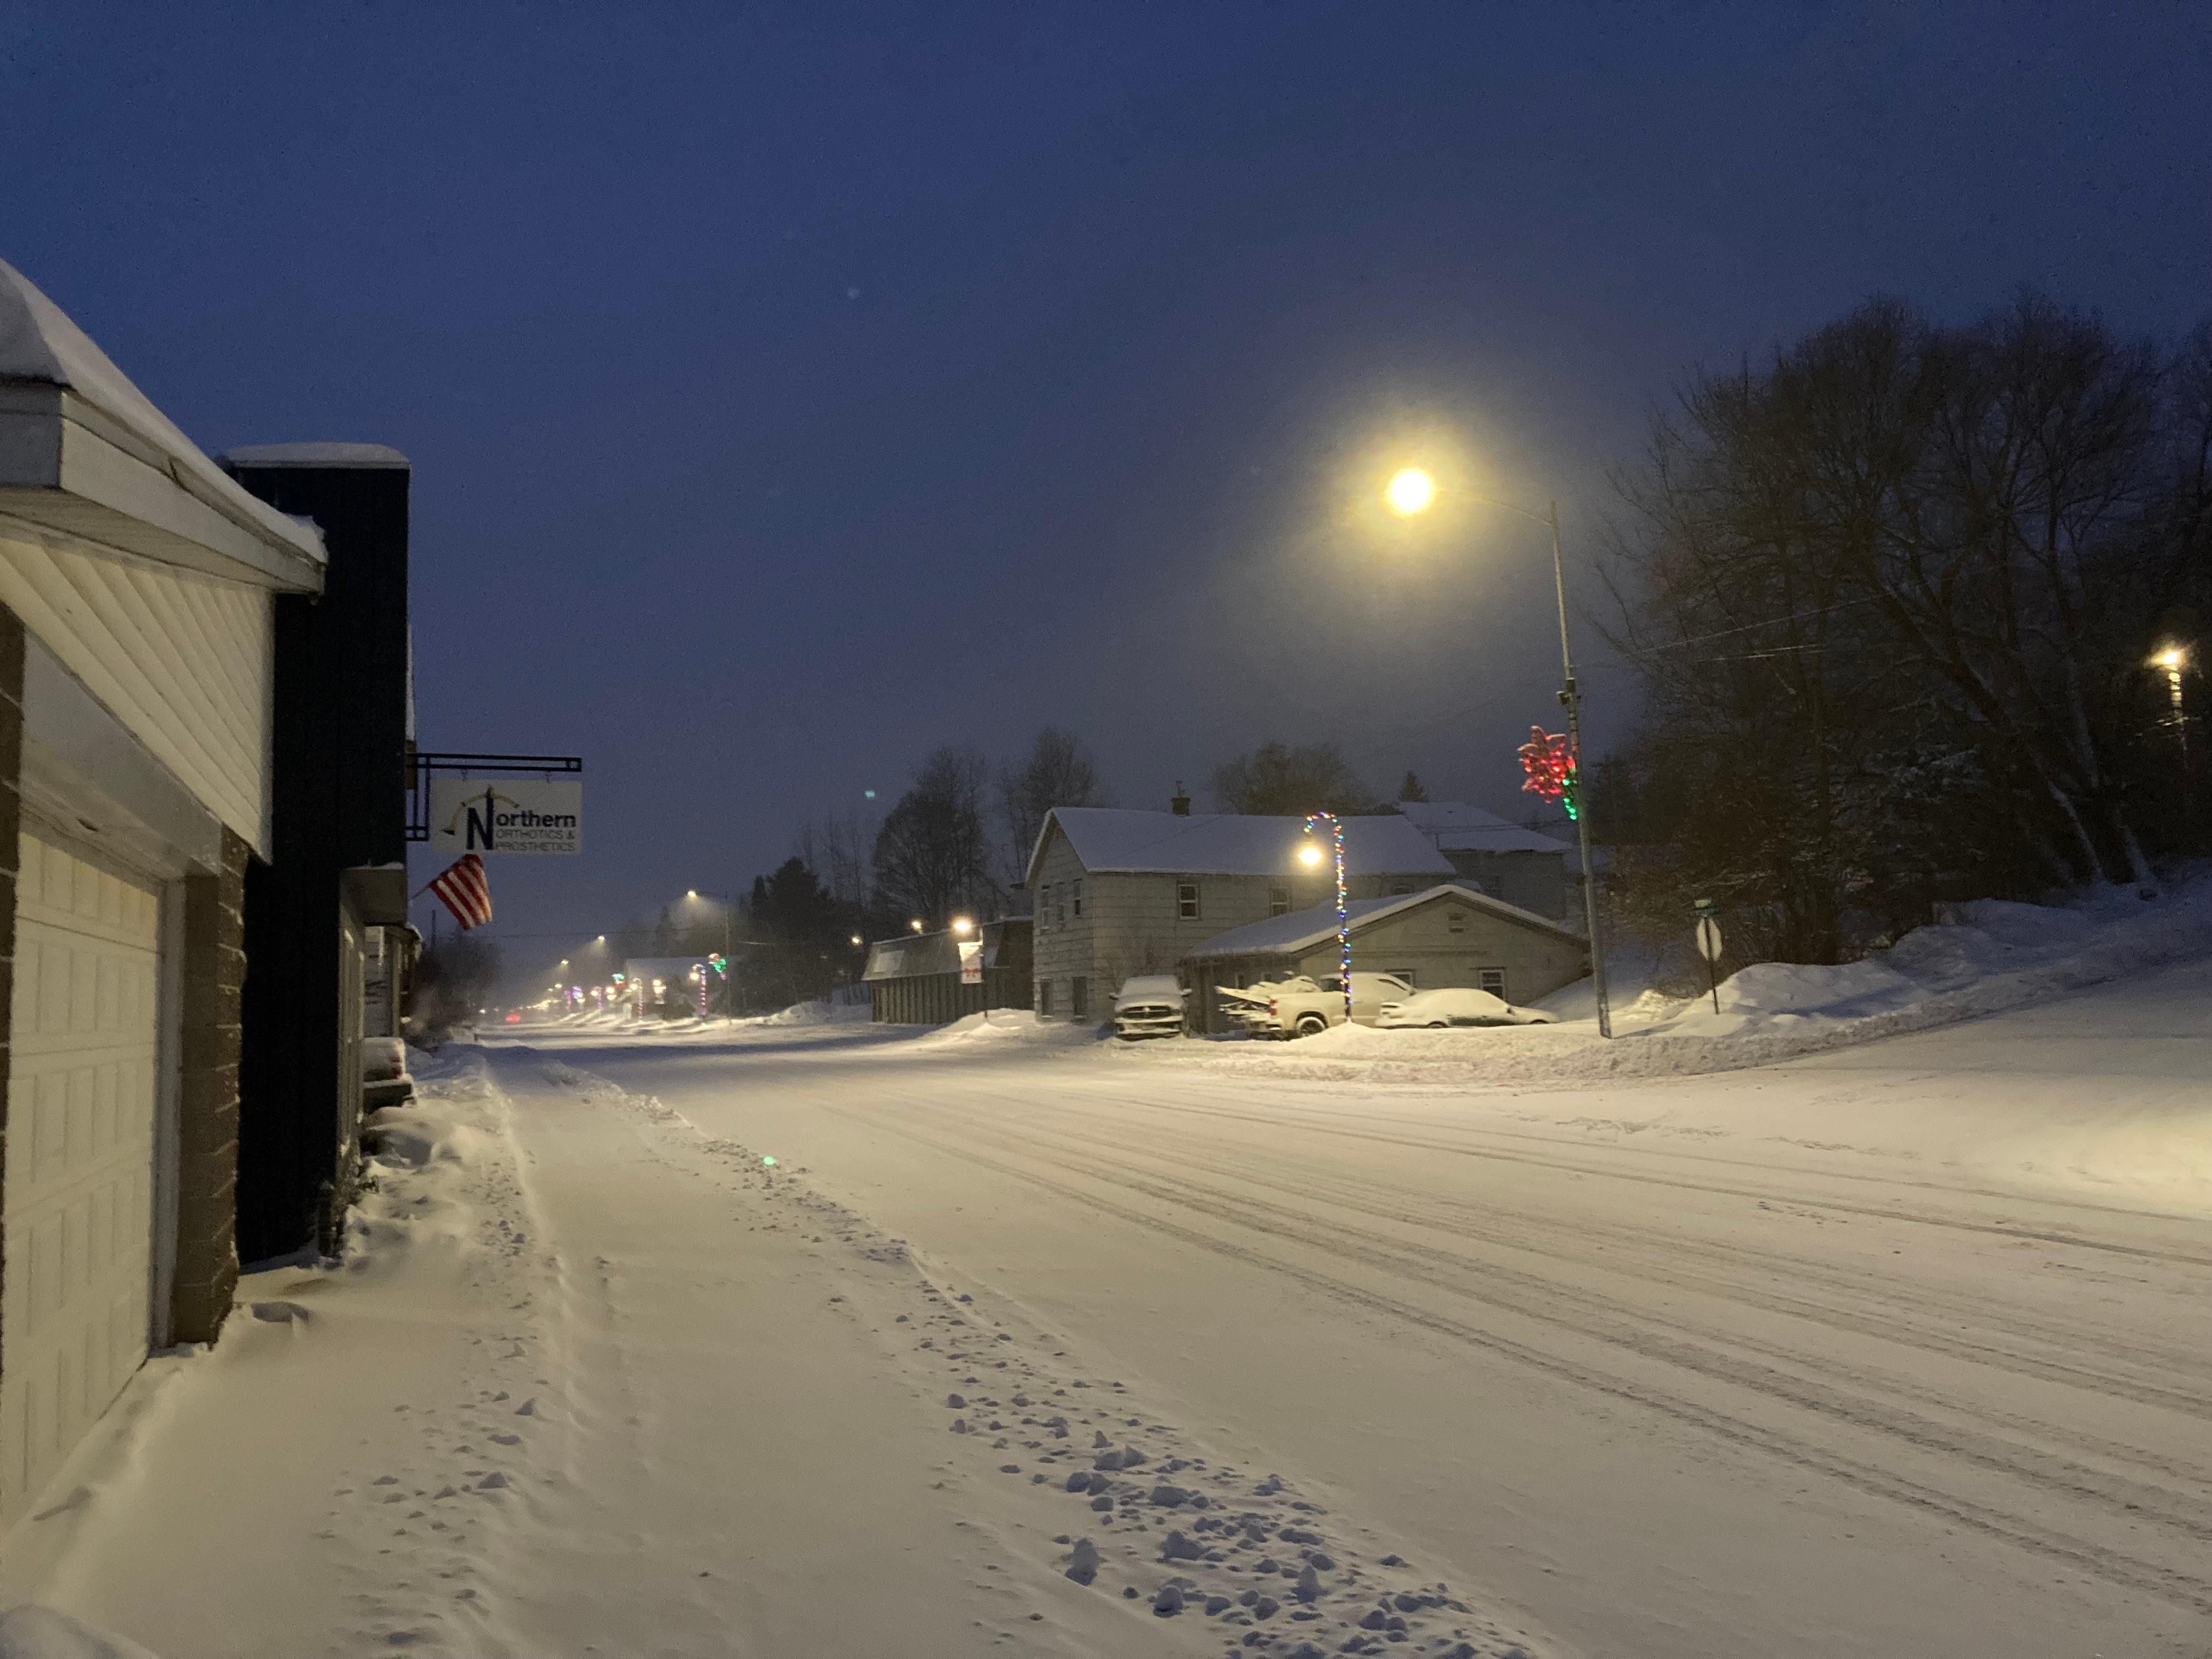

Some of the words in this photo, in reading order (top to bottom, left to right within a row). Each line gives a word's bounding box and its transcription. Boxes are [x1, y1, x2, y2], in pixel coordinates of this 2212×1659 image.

[467, 790, 576, 850] Northern
[496, 829, 563, 839] ORTHOTICS
[567, 830, 575, 839] &
[496, 841, 575, 851] PROSTHETICS
